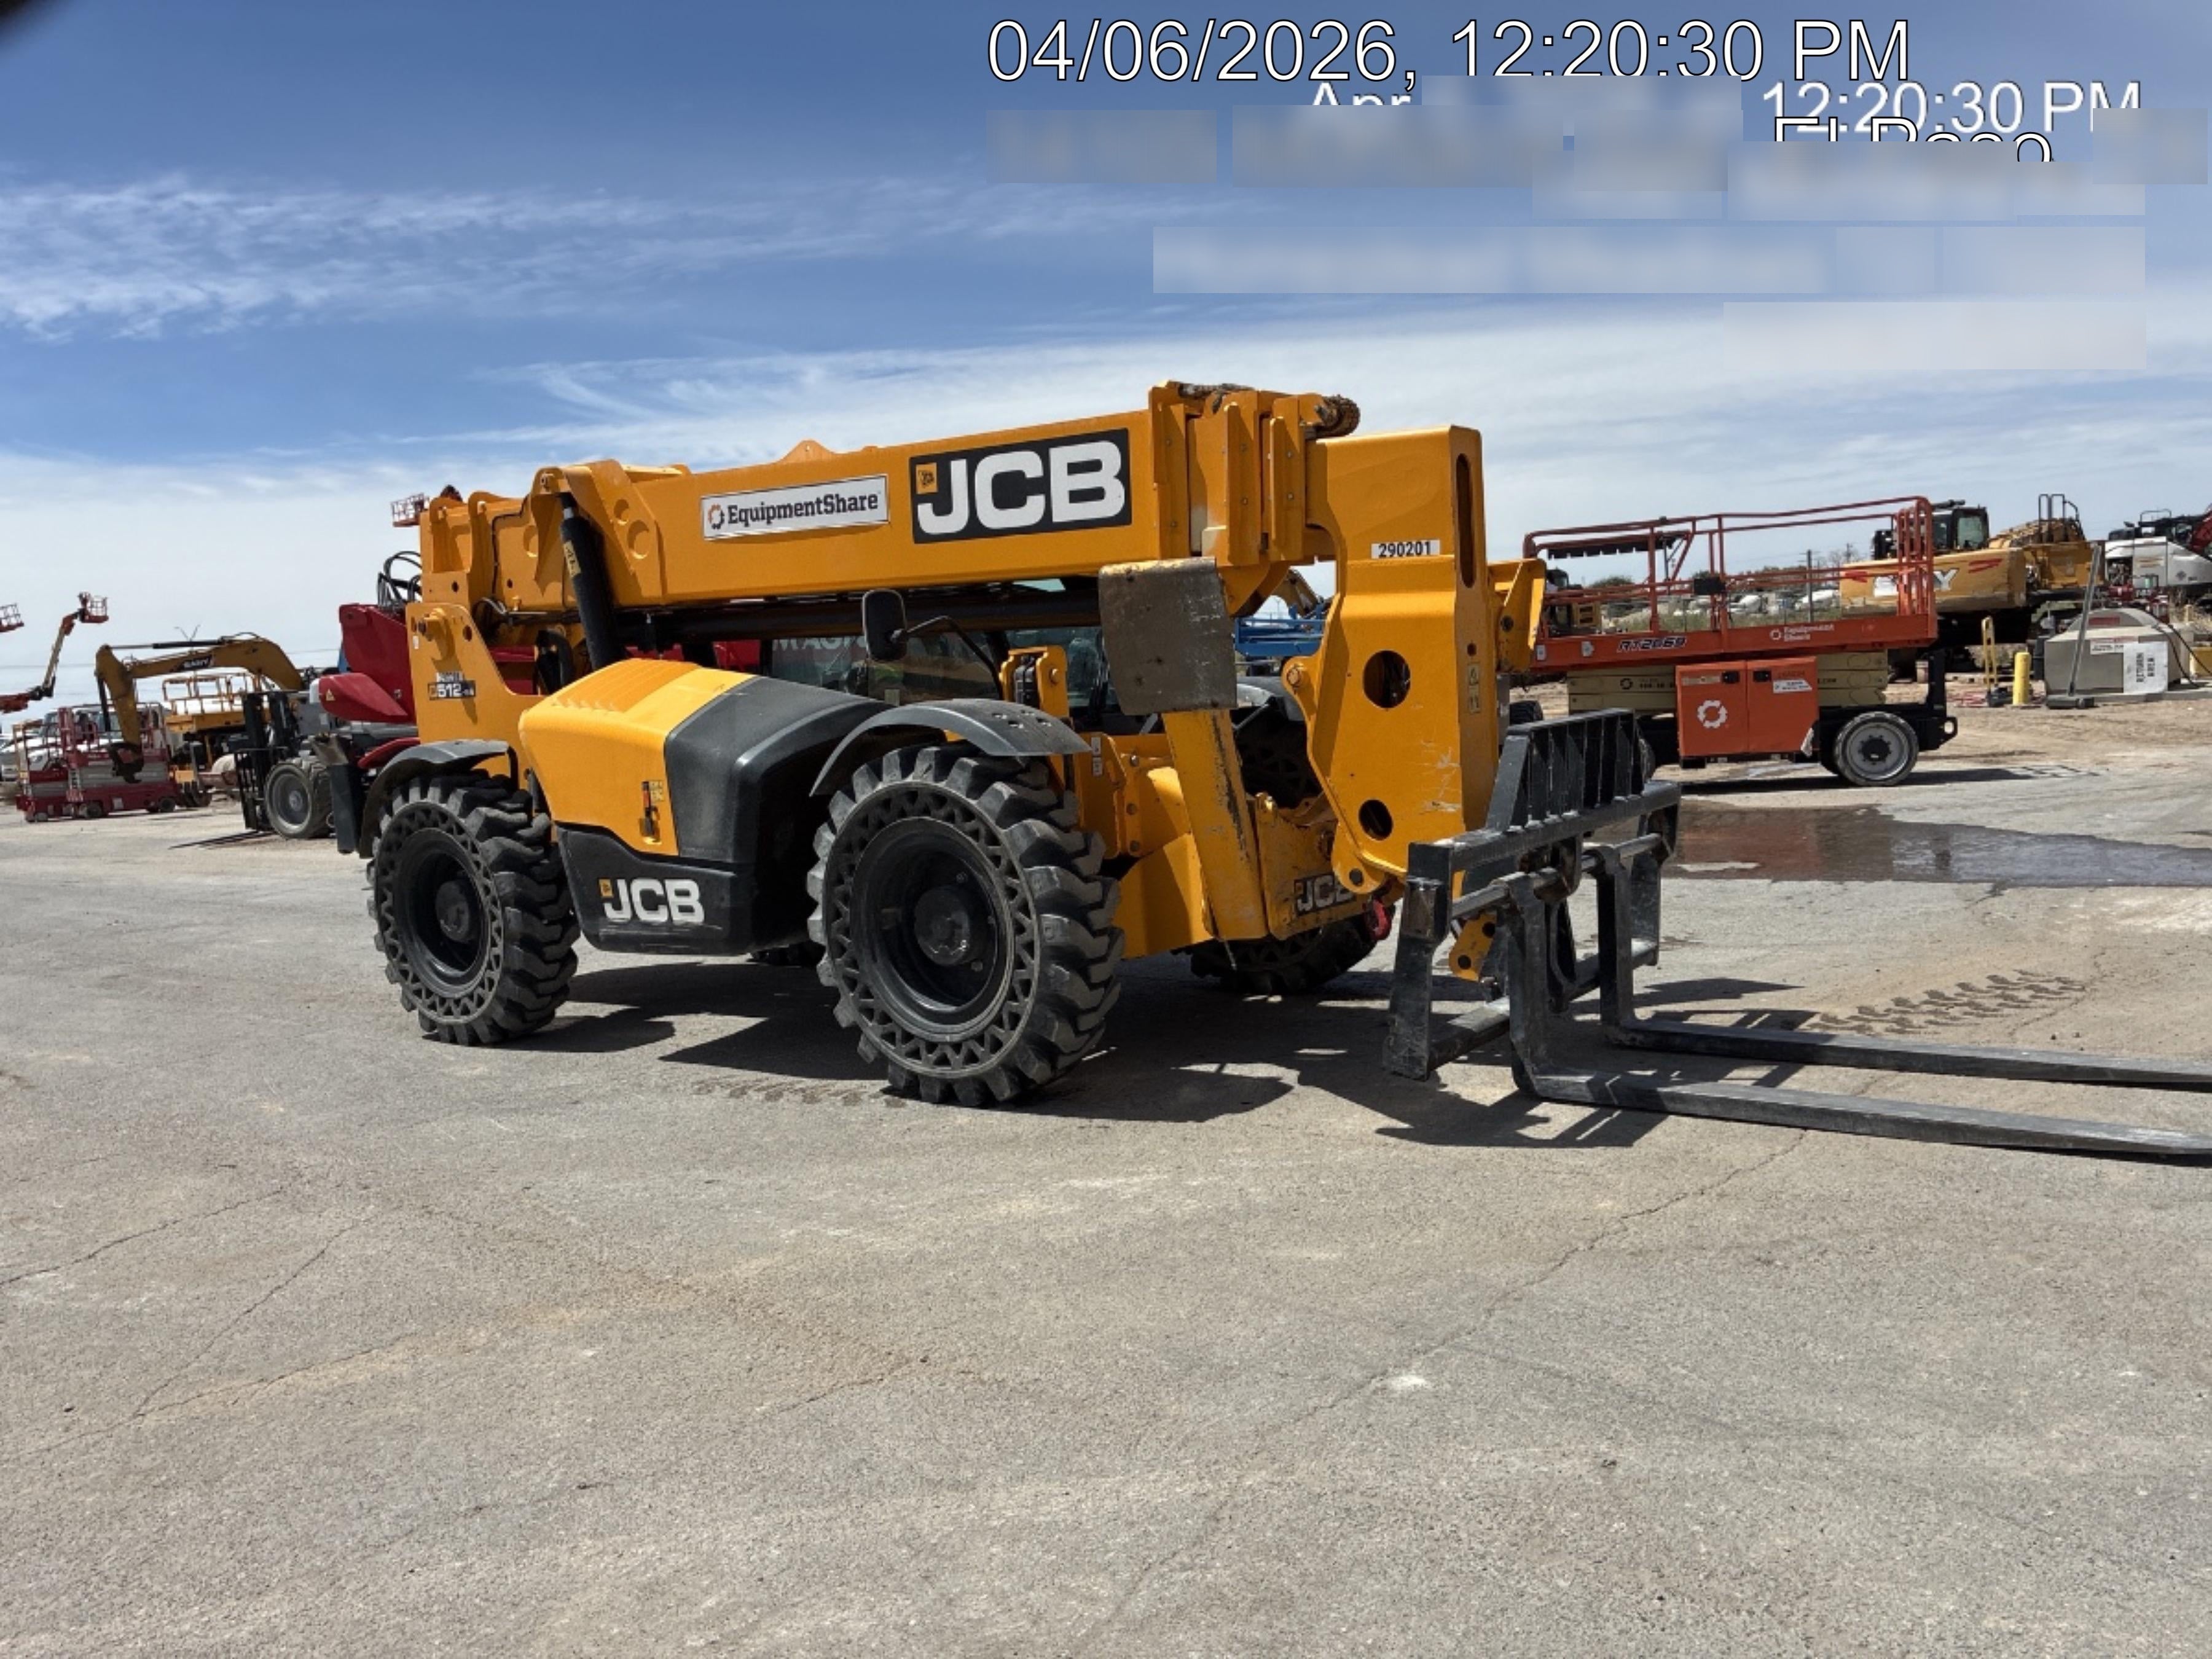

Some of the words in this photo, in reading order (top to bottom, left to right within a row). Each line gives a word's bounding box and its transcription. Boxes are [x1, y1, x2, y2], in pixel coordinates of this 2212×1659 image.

[917, 441, 1125, 535] JCB
[728, 493, 878, 528] EquipmentShare
[1378, 541, 1430, 558] 290201
[604, 878, 705, 925] JCB
